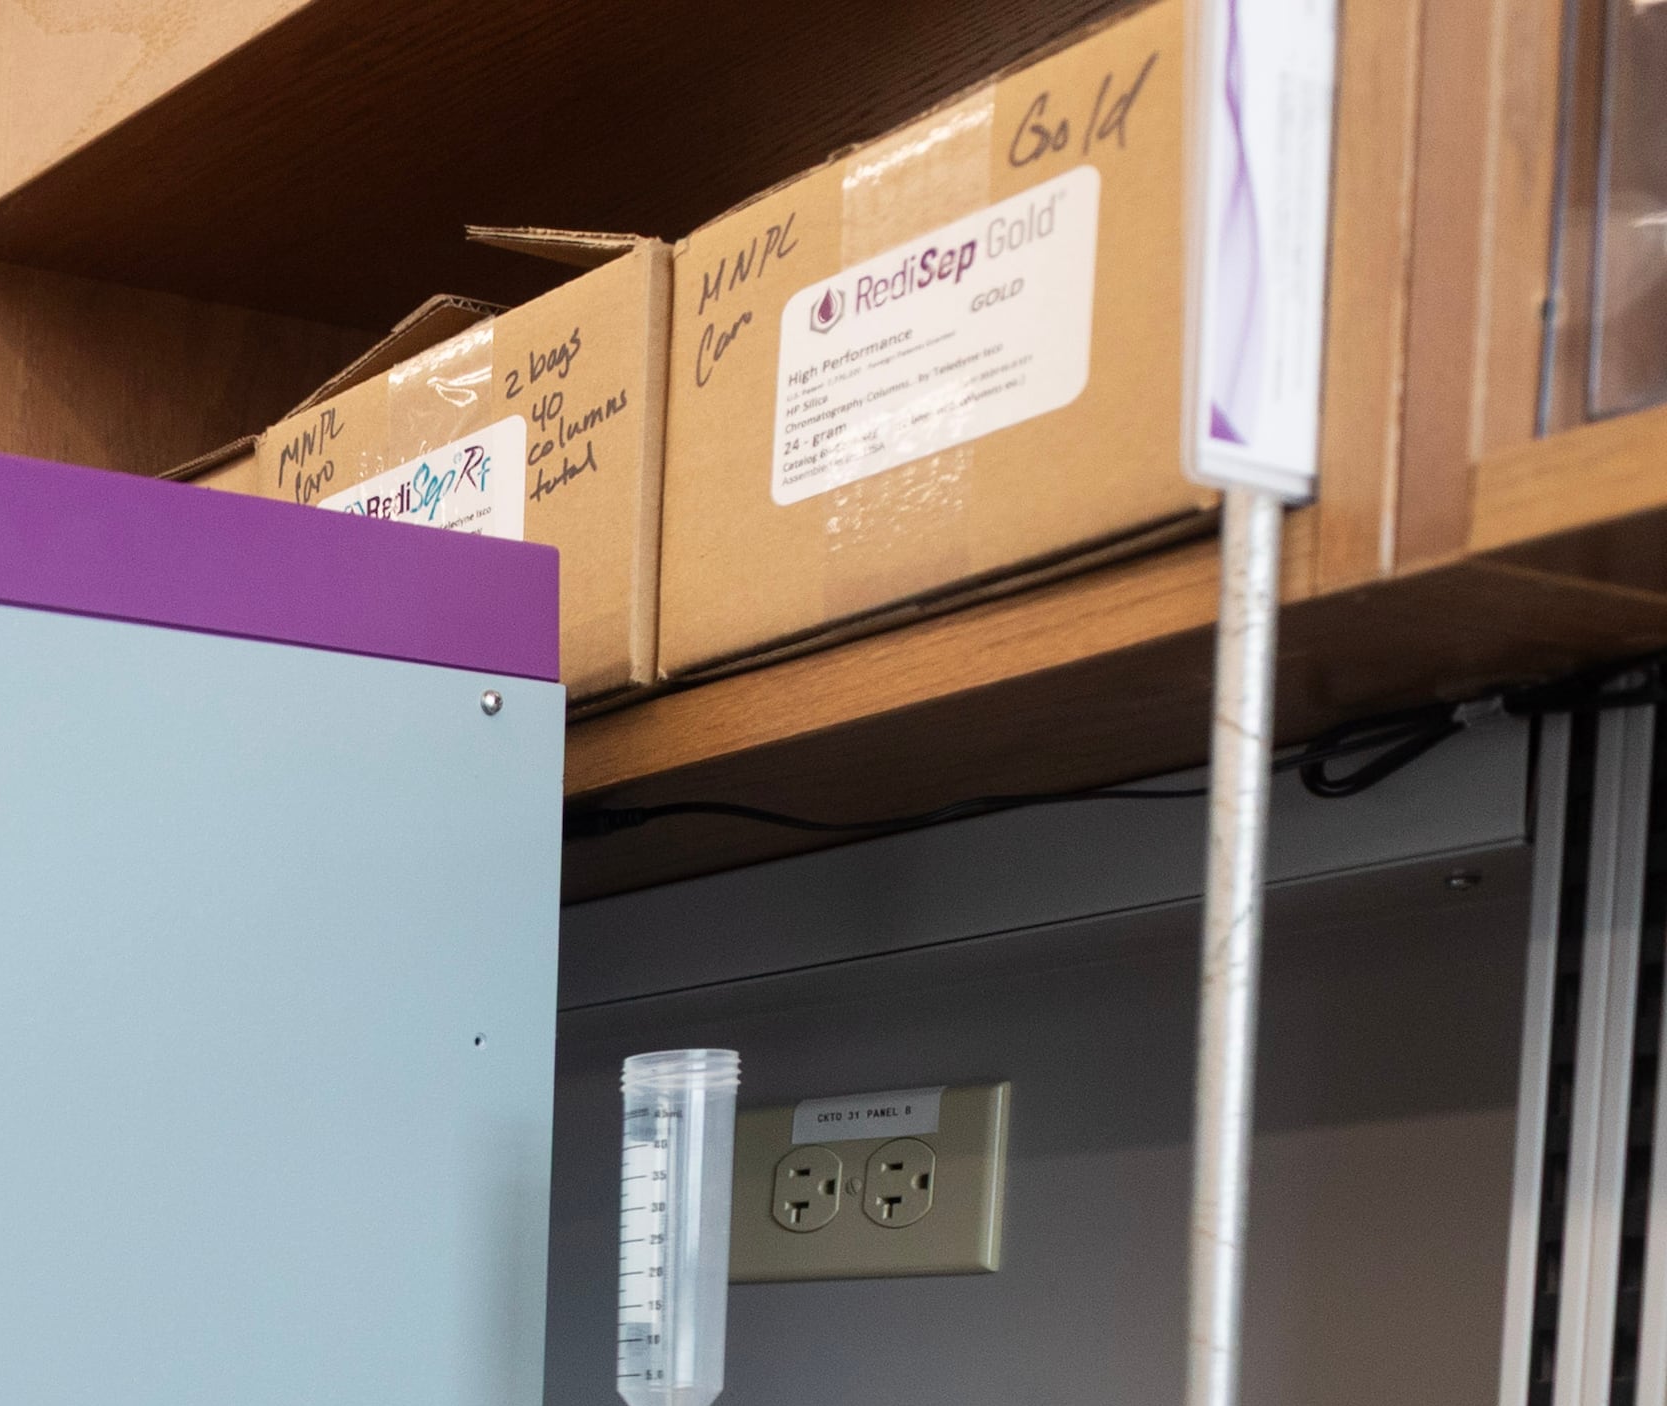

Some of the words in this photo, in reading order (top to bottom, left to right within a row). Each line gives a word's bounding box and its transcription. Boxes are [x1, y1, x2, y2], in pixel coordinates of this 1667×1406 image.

[1009, 51, 1160, 168] Gold
[855, 240, 977, 315] RediSep
[970, 277, 1025, 314] GOLD
[505, 369, 524, 400] 2
[529, 326, 582, 385] bags
[788, 367, 817, 387] High
[822, 328, 913, 372] Performance
[531, 391, 564, 432] 40
[785, 399, 863, 434] Chromatography
[803, 395, 828, 413] Silica
[527, 388, 628, 466] columns
[784, 437, 800, 455] 24
[812, 423, 847, 448] gram
[848, 1111, 860, 1120] 31
[866, 1107, 899, 1118] PANEL
[652, 1170, 667, 1181] 35
[651, 1202, 666, 1213] 30
